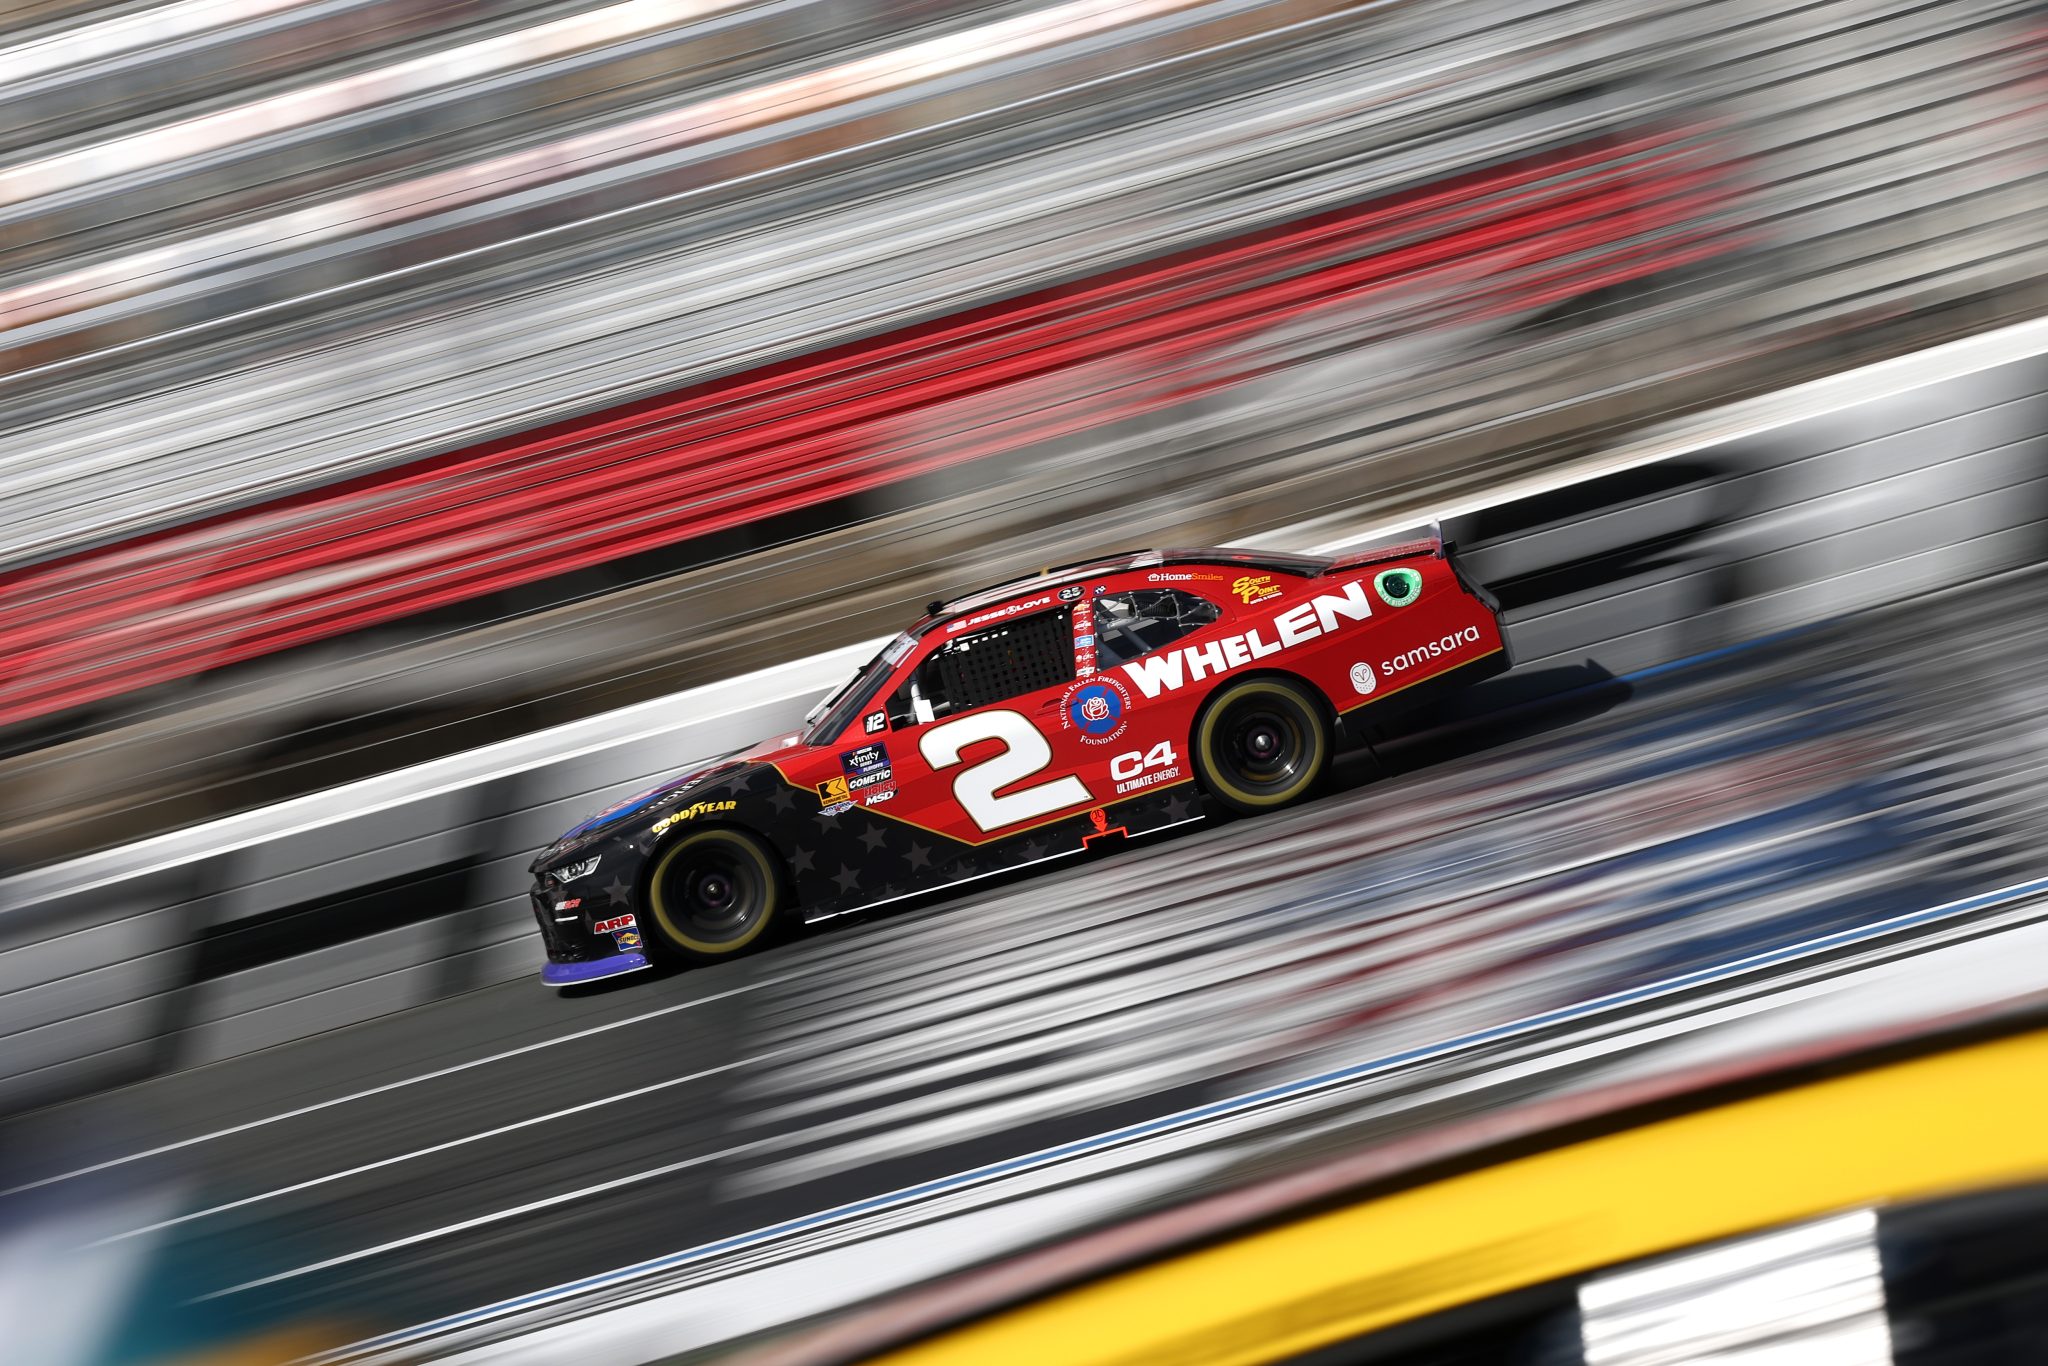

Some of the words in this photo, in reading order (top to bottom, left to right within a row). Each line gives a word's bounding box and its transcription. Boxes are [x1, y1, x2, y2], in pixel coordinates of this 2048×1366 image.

[1160, 572, 1224, 581] HomeSmiles
[1232, 576, 1271, 595] SOUTH
[1241, 585, 1281, 604] POINT
[968, 608, 1006, 626] JESSE
[1016, 596, 1051, 611] LOVE
[1121, 581, 1373, 699] WHELEN
[1381, 625, 1480, 676] samsara
[1060, 691, 1072, 730] NATIONAL
[1068, 677, 1096, 692] FALLEN
[1097, 675, 1132, 710] FIREFIGHTERS
[867, 712, 885, 733] 12
[1080, 722, 1128, 745] FOUNDATION
[849, 751, 880, 767] xfinity
[919, 709, 1094, 832] 2
[1110, 740, 1178, 781] C4
[849, 769, 891, 789] COMETIC
[1116, 774, 1154, 794] ULTIMATE
[1153, 766, 1179, 784] ENERGY
[865, 790, 894, 807] MSD
[651, 800, 737, 833] GOODYEAR
[595, 914, 634, 933] ARP
